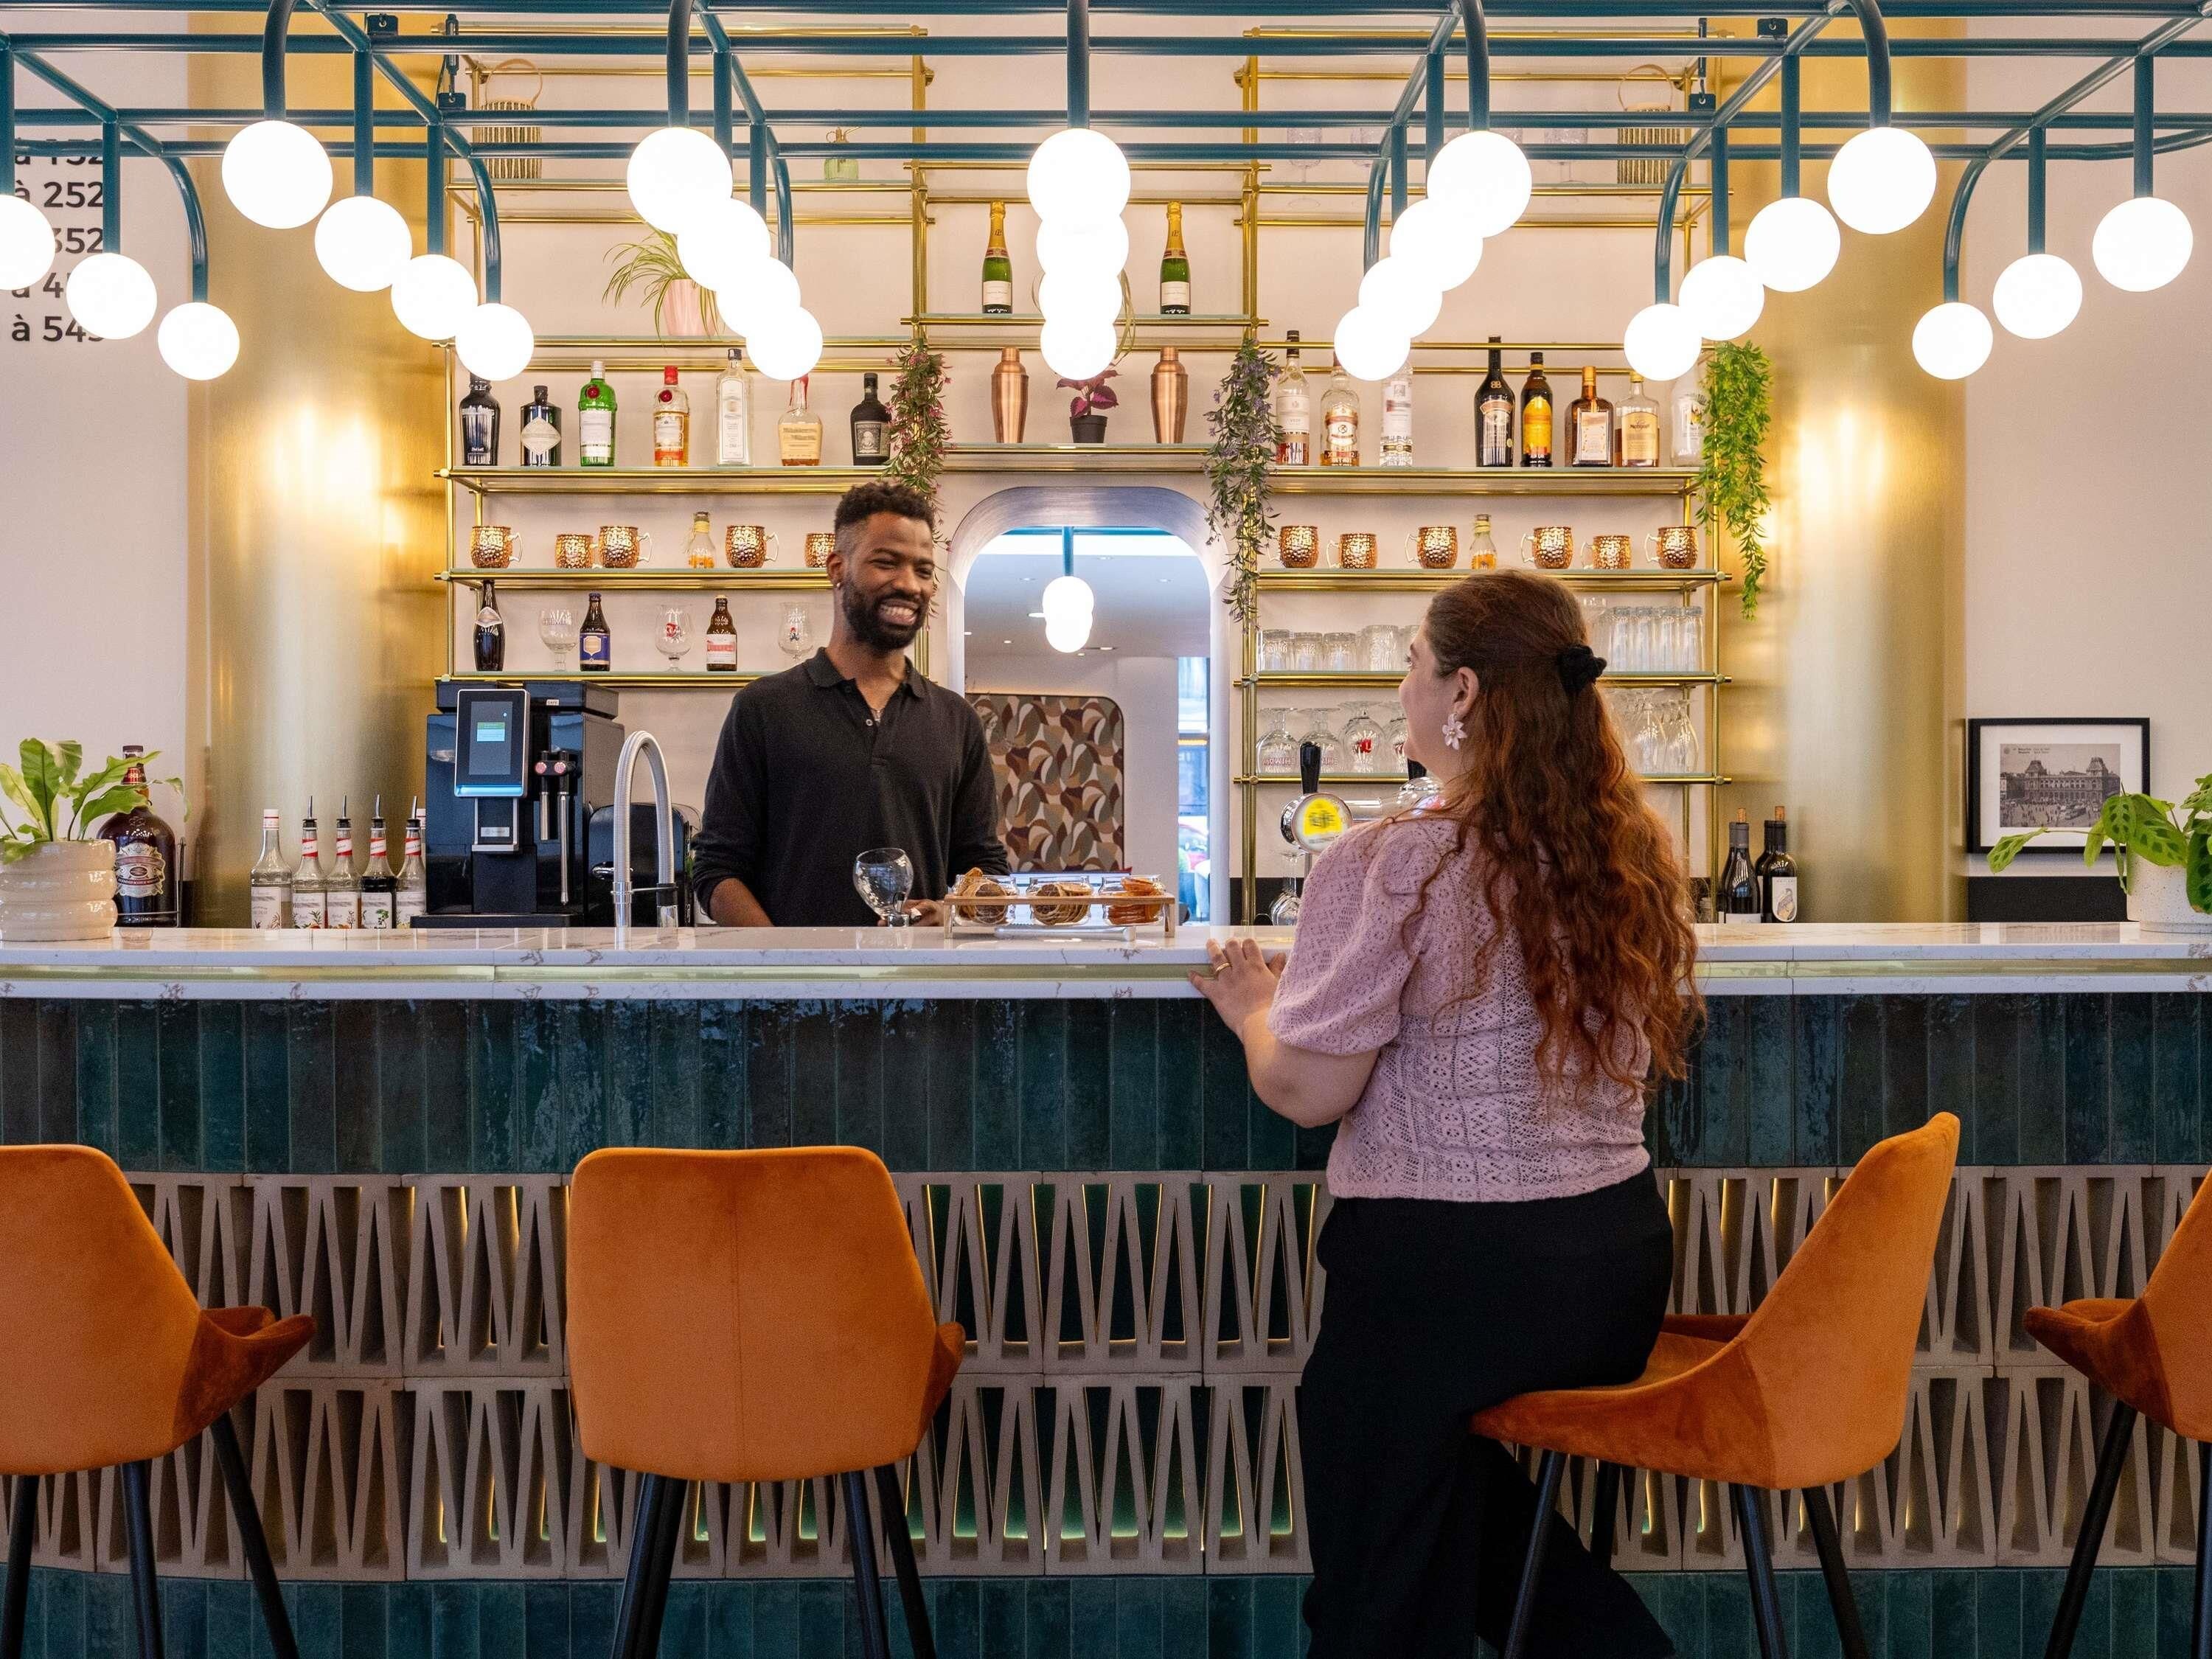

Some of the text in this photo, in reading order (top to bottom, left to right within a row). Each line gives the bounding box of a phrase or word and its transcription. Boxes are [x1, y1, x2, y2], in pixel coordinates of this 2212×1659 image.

[44, 181, 102, 208] 252
[12, 313, 103, 342] à 54
